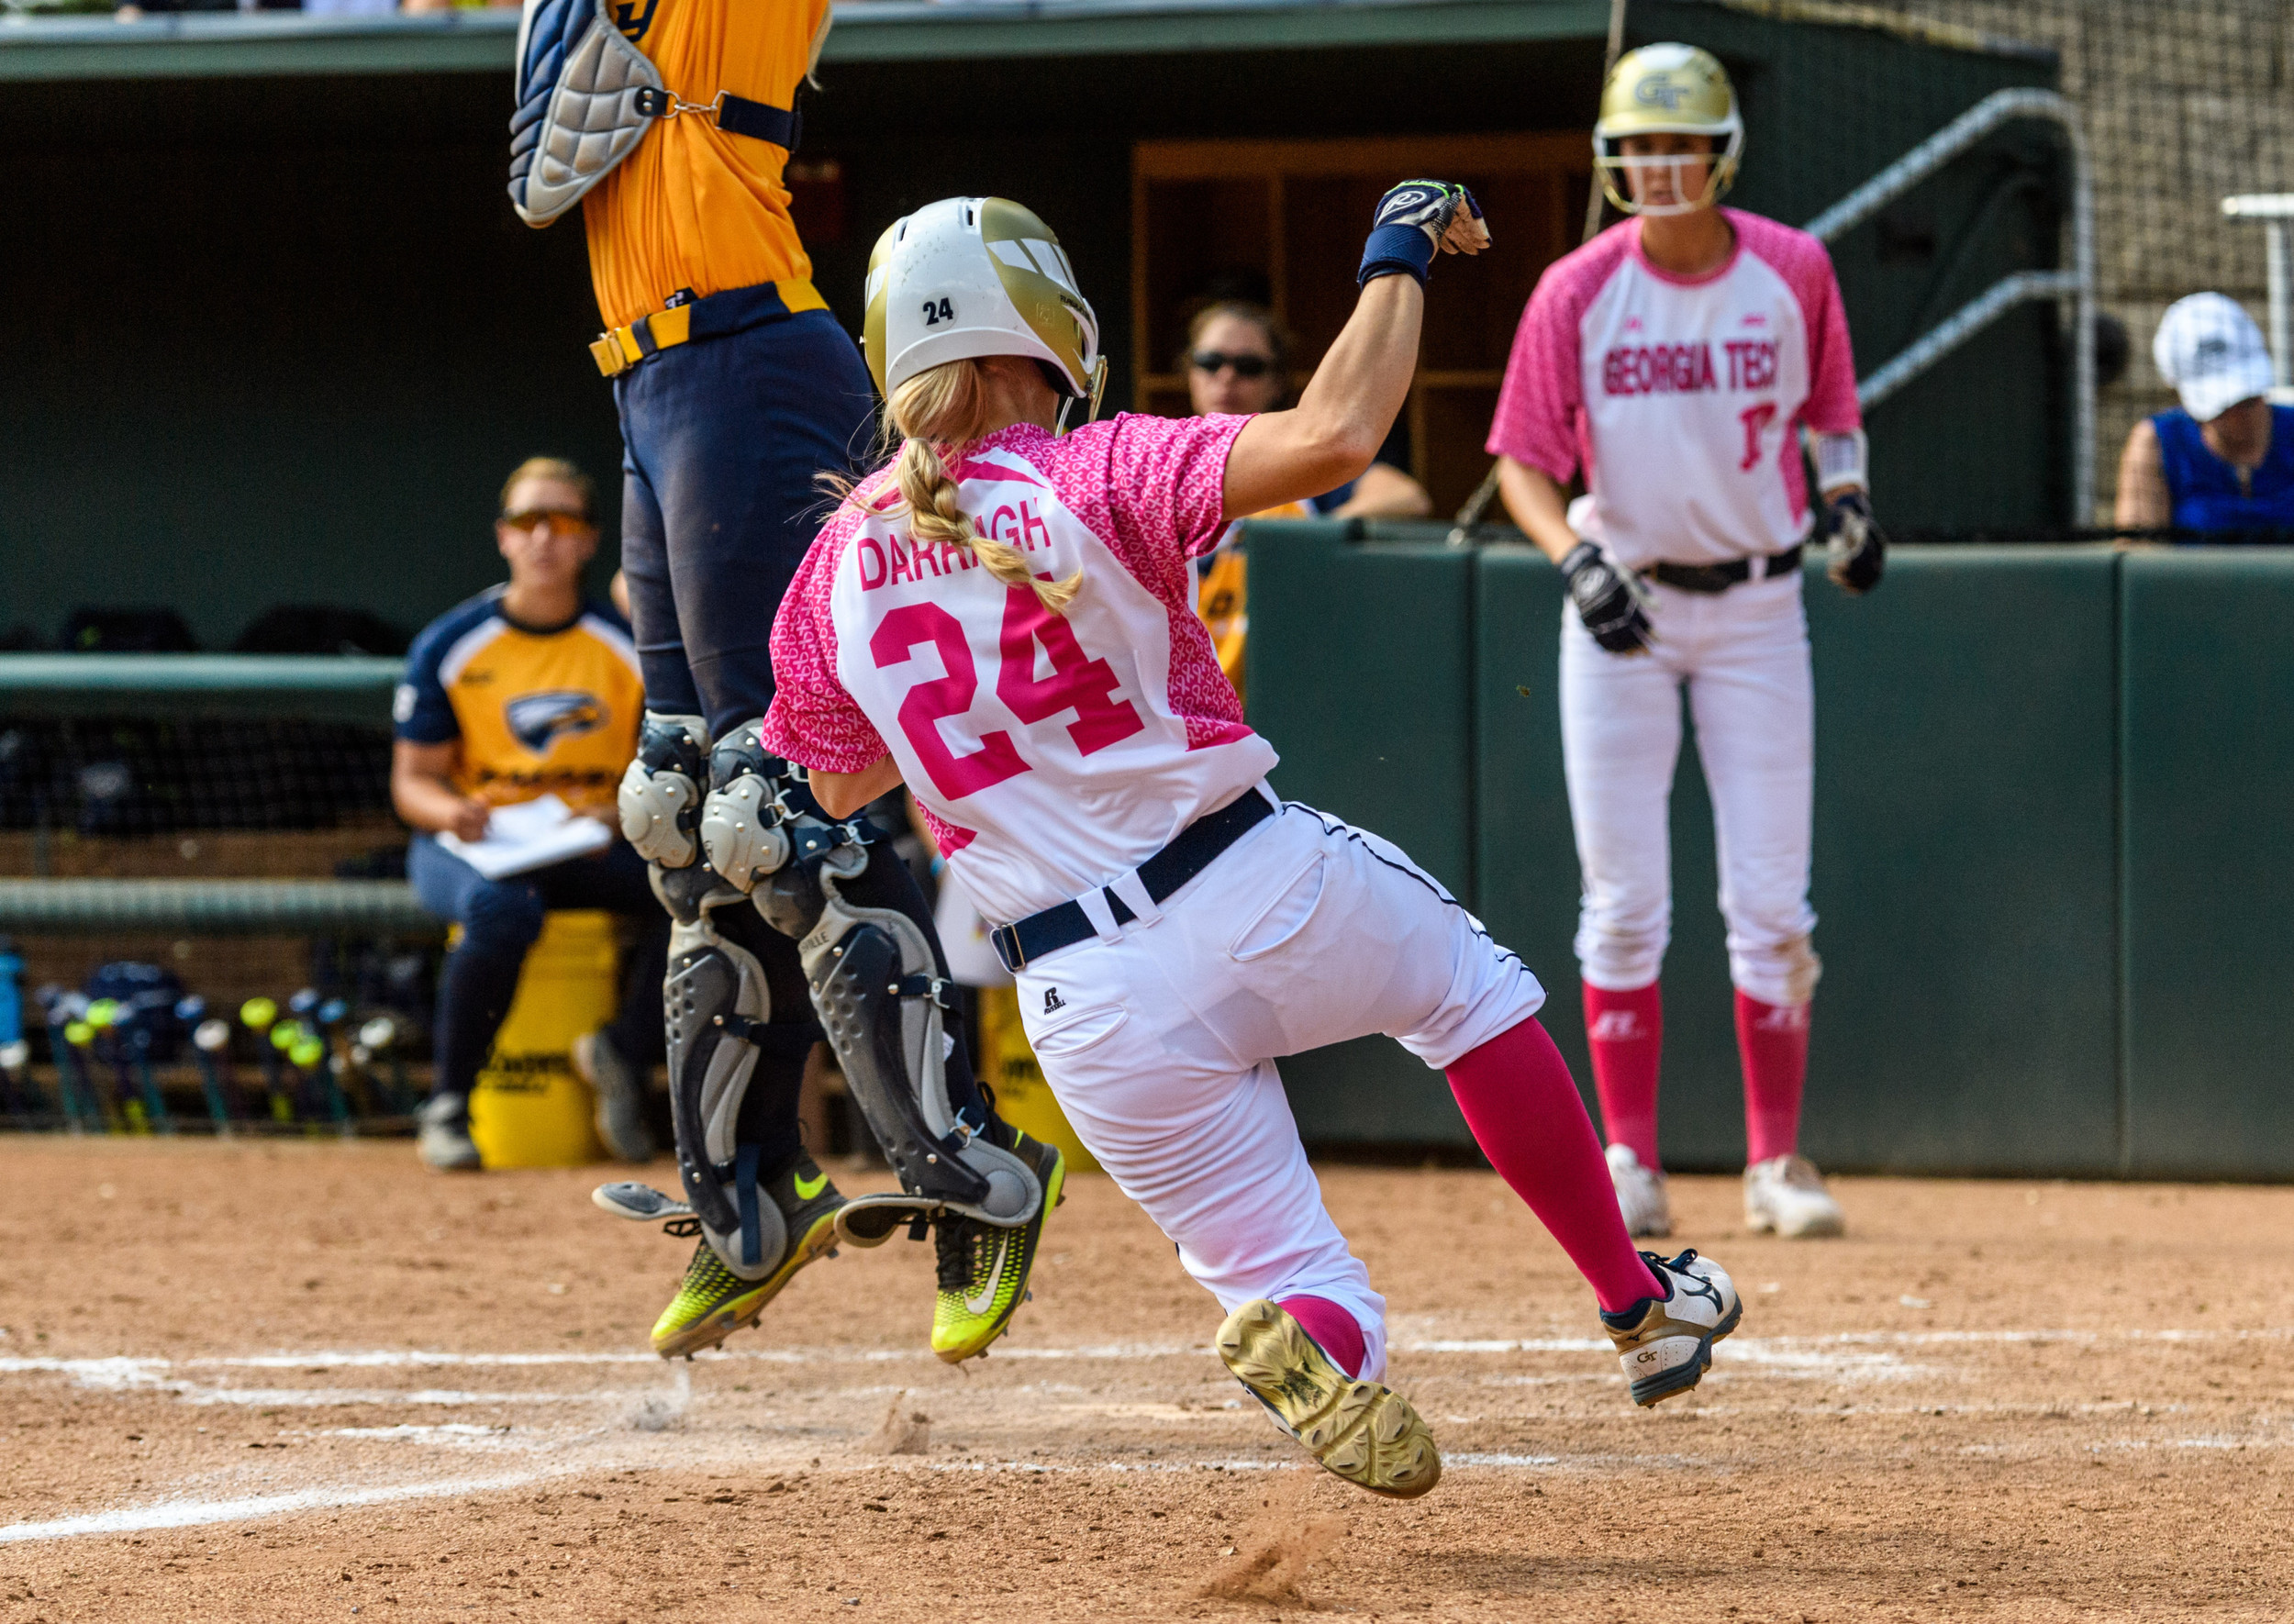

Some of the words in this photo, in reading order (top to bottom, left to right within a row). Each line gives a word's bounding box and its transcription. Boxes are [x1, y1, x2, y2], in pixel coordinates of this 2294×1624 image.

[922, 296, 953, 326] 24
[1604, 342, 1718, 396] GEORGIA
[869, 571, 1145, 802] 24
[1043, 999, 1066, 1016] RUSSELL
[1637, 1351, 1658, 1363] GT
